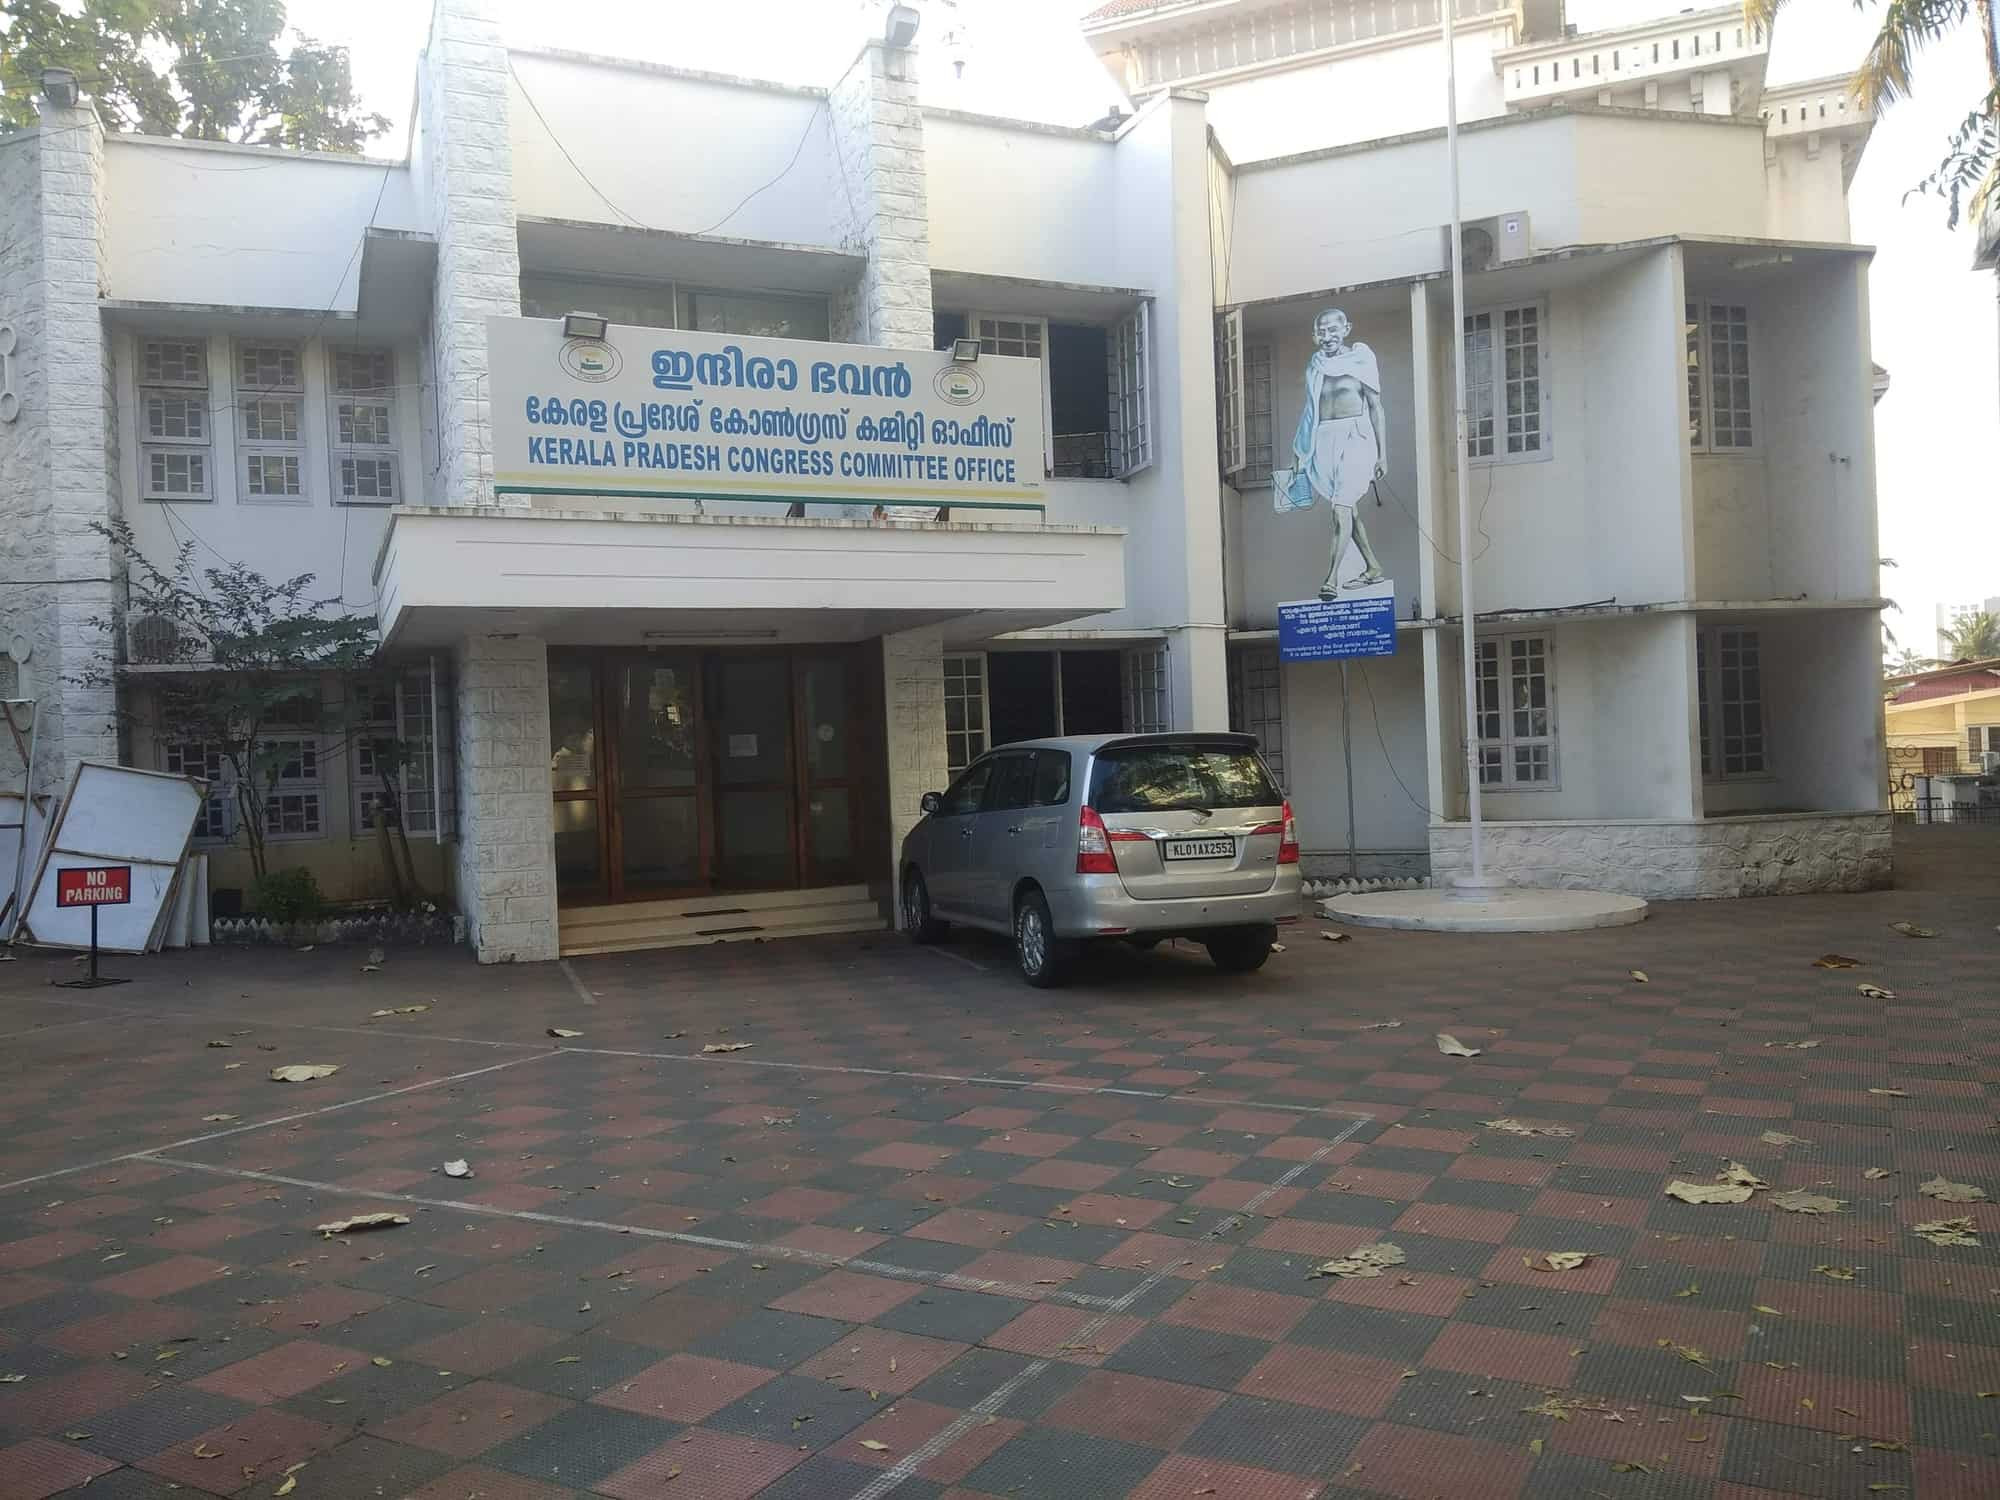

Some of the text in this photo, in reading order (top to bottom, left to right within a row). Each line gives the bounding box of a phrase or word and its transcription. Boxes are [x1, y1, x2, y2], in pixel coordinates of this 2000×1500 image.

[651, 345, 798, 391] ഇന്ദിരാ
[811, 361, 912, 398] ഭവൻ
[526, 395, 1015, 451] കേരള പ്രദേശ് കോൺഗ്രസ് കമ്മിറ്റി ഓഫീസ്
[528, 436, 1016, 483] KERALA PRADESH CONGRESS COMMITTEE OFFICE
[1173, 843, 1233, 856] KL01AX2552
[66, 886, 122, 902] PARKING
[86, 871, 107, 886] NO
